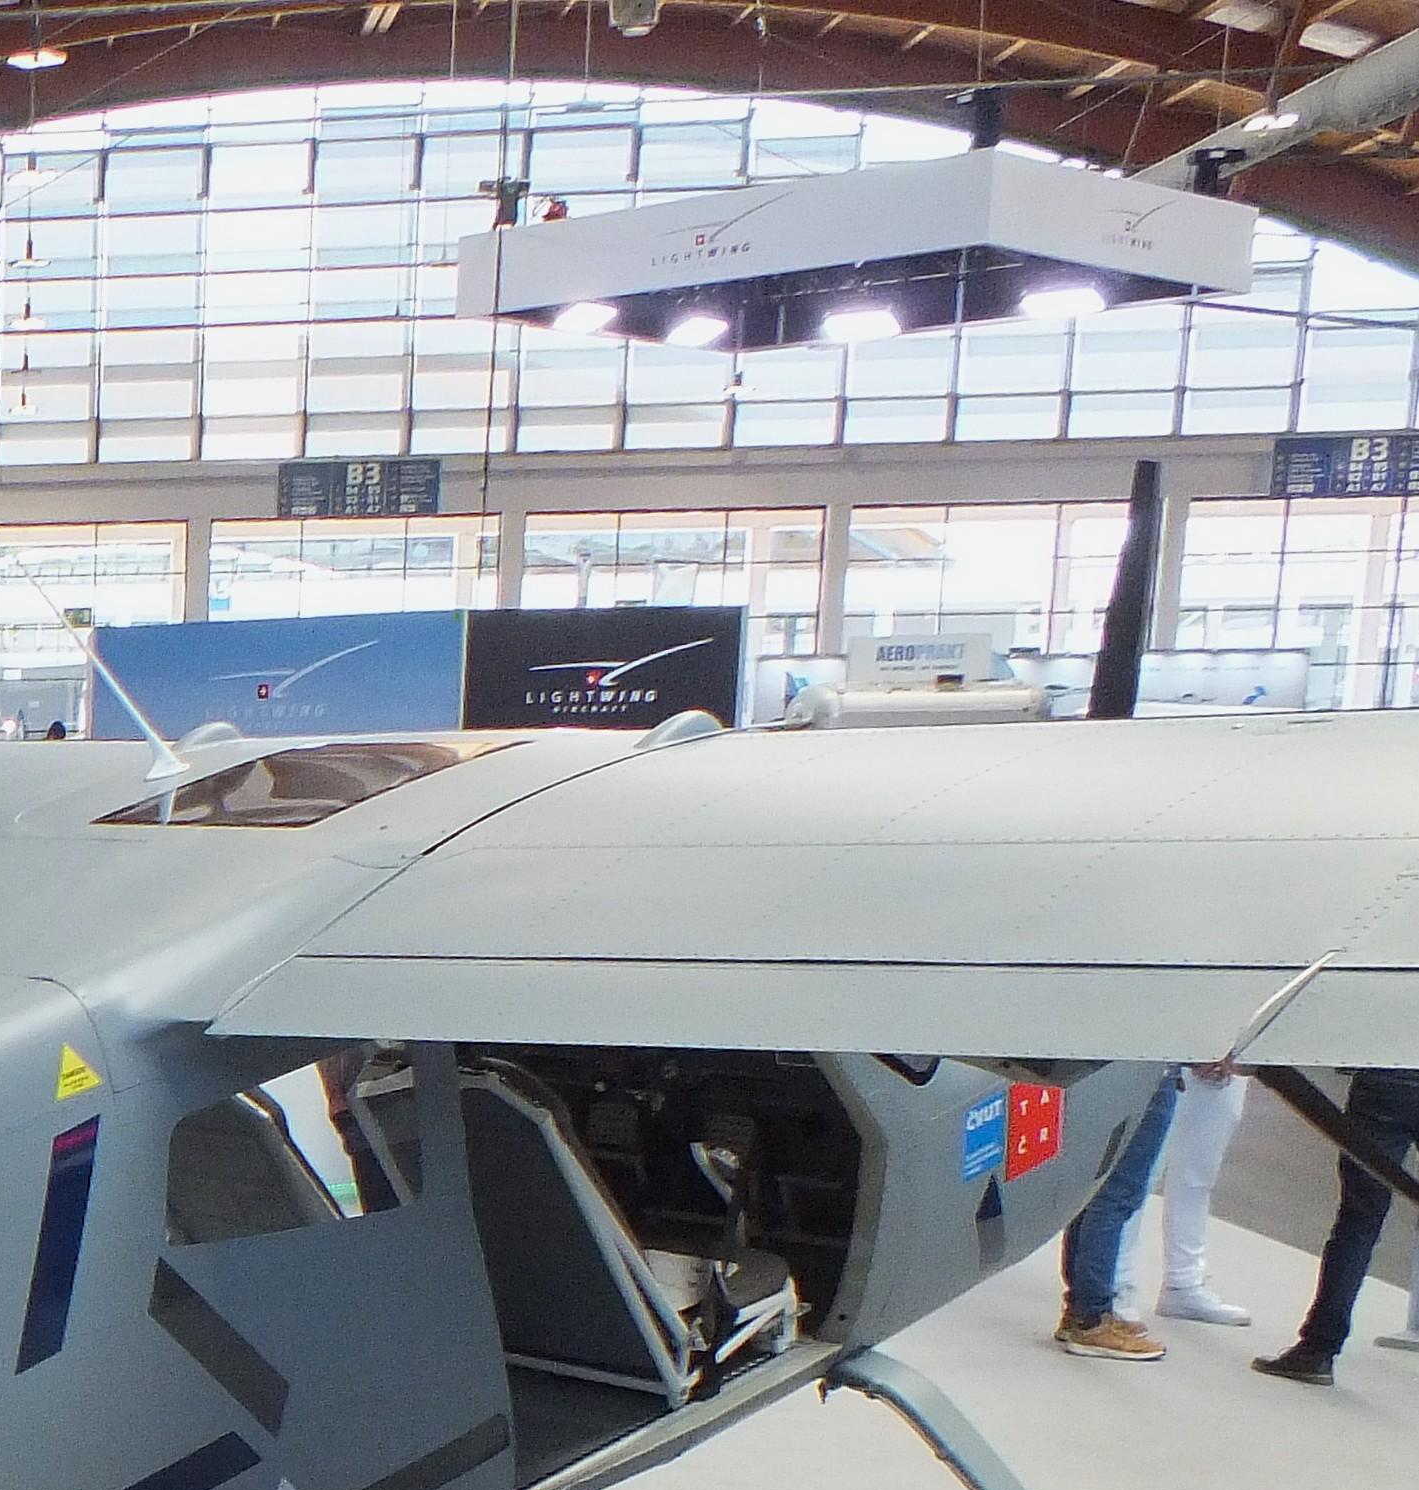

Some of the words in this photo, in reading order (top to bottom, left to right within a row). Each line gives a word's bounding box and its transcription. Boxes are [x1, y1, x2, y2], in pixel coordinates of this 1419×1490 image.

[651, 242, 750, 266] LIGHTWING
[1350, 438, 1388, 461] B3
[346, 463, 381, 484] B3
[525, 690, 657, 705] LIGHTWING
